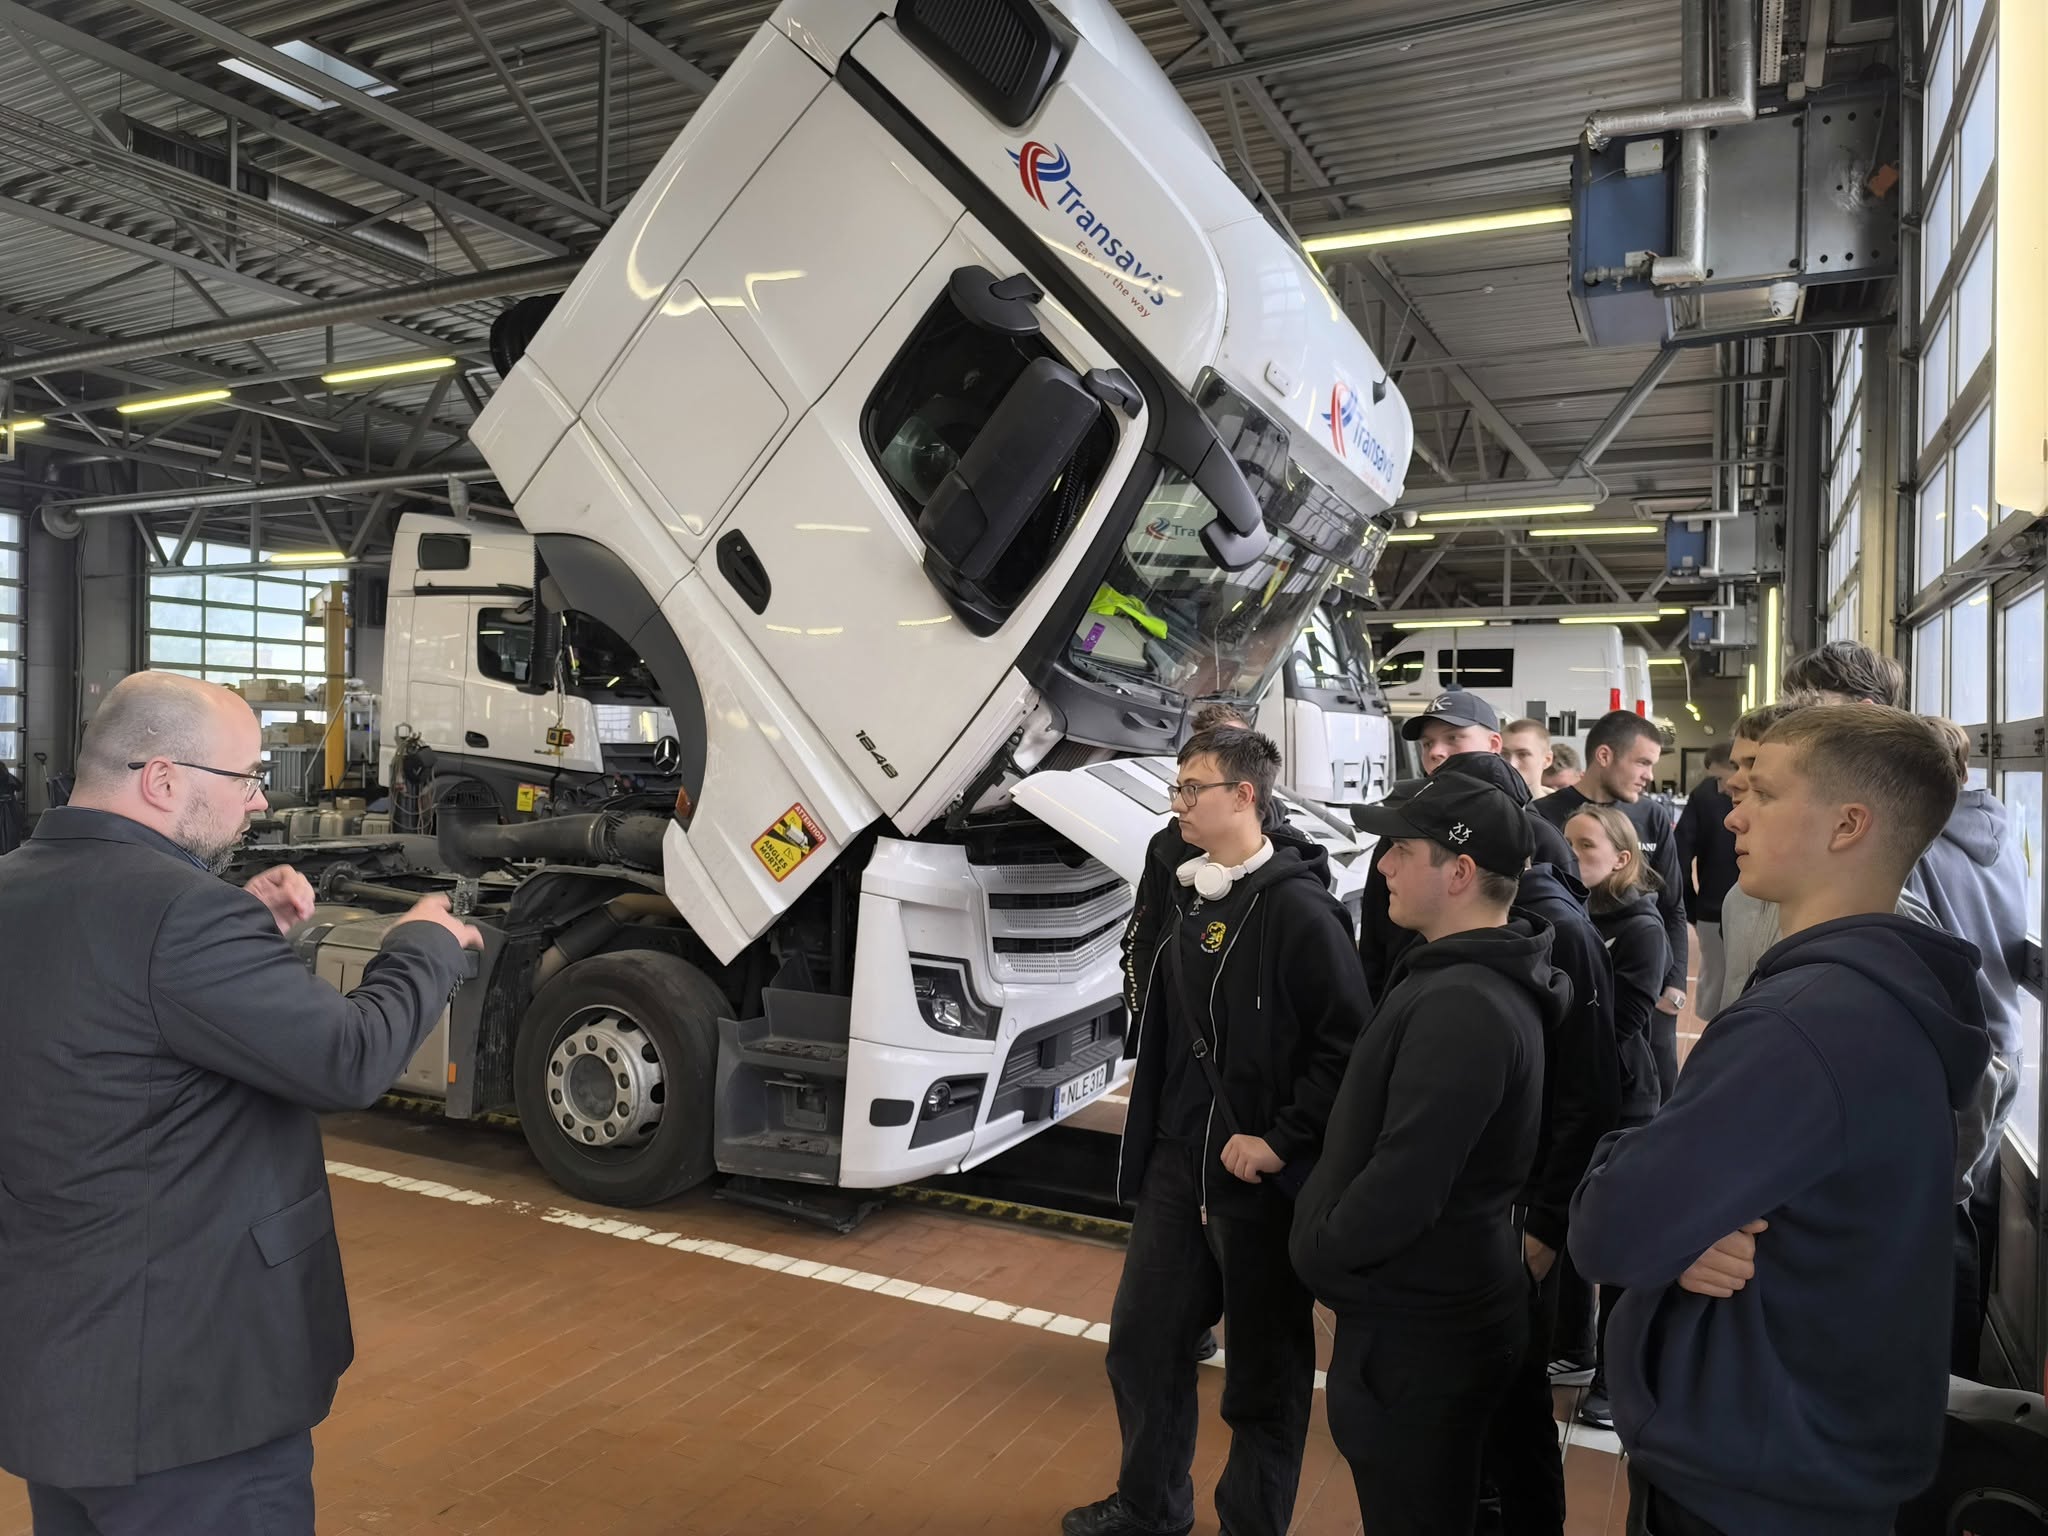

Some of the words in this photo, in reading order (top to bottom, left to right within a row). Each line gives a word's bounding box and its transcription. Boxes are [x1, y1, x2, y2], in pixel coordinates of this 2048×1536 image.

[1112, 278, 1130, 296] the
[1131, 297, 1151, 317] way
[1171, 524, 1200, 537] Tra
[794, 805, 825, 841] ATTENTION
[760, 846, 782, 873] MORTS
[763, 840, 788, 869] ANGLES
